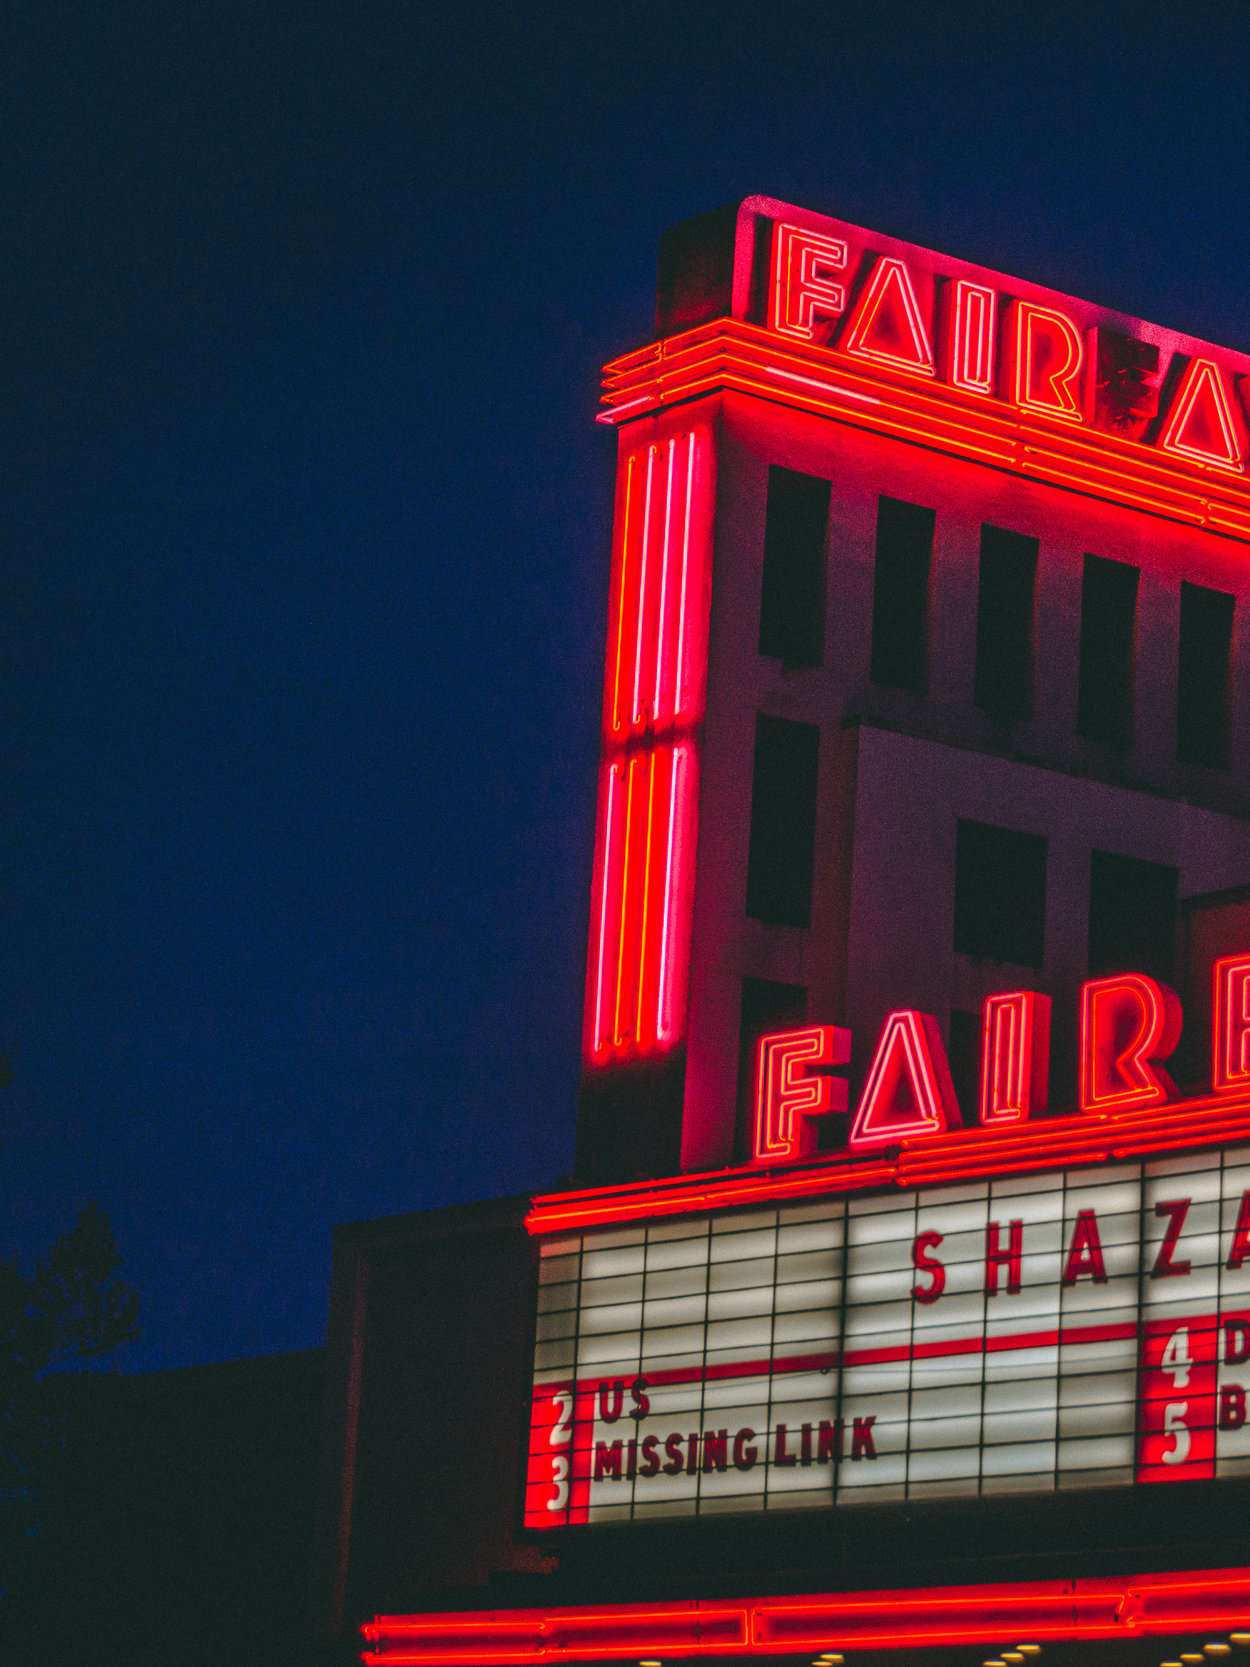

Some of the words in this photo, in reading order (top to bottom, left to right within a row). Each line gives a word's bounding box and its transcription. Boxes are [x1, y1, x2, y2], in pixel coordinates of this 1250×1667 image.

[1161, 1326, 1193, 1389] 4
[549, 1391, 573, 1447] 2
[598, 1378, 651, 1423] US
[1161, 1401, 1192, 1465] 5
[547, 1455, 570, 1511] 3
[593, 1427, 759, 1483] MISSING
[774, 1415, 877, 1468] LINK
